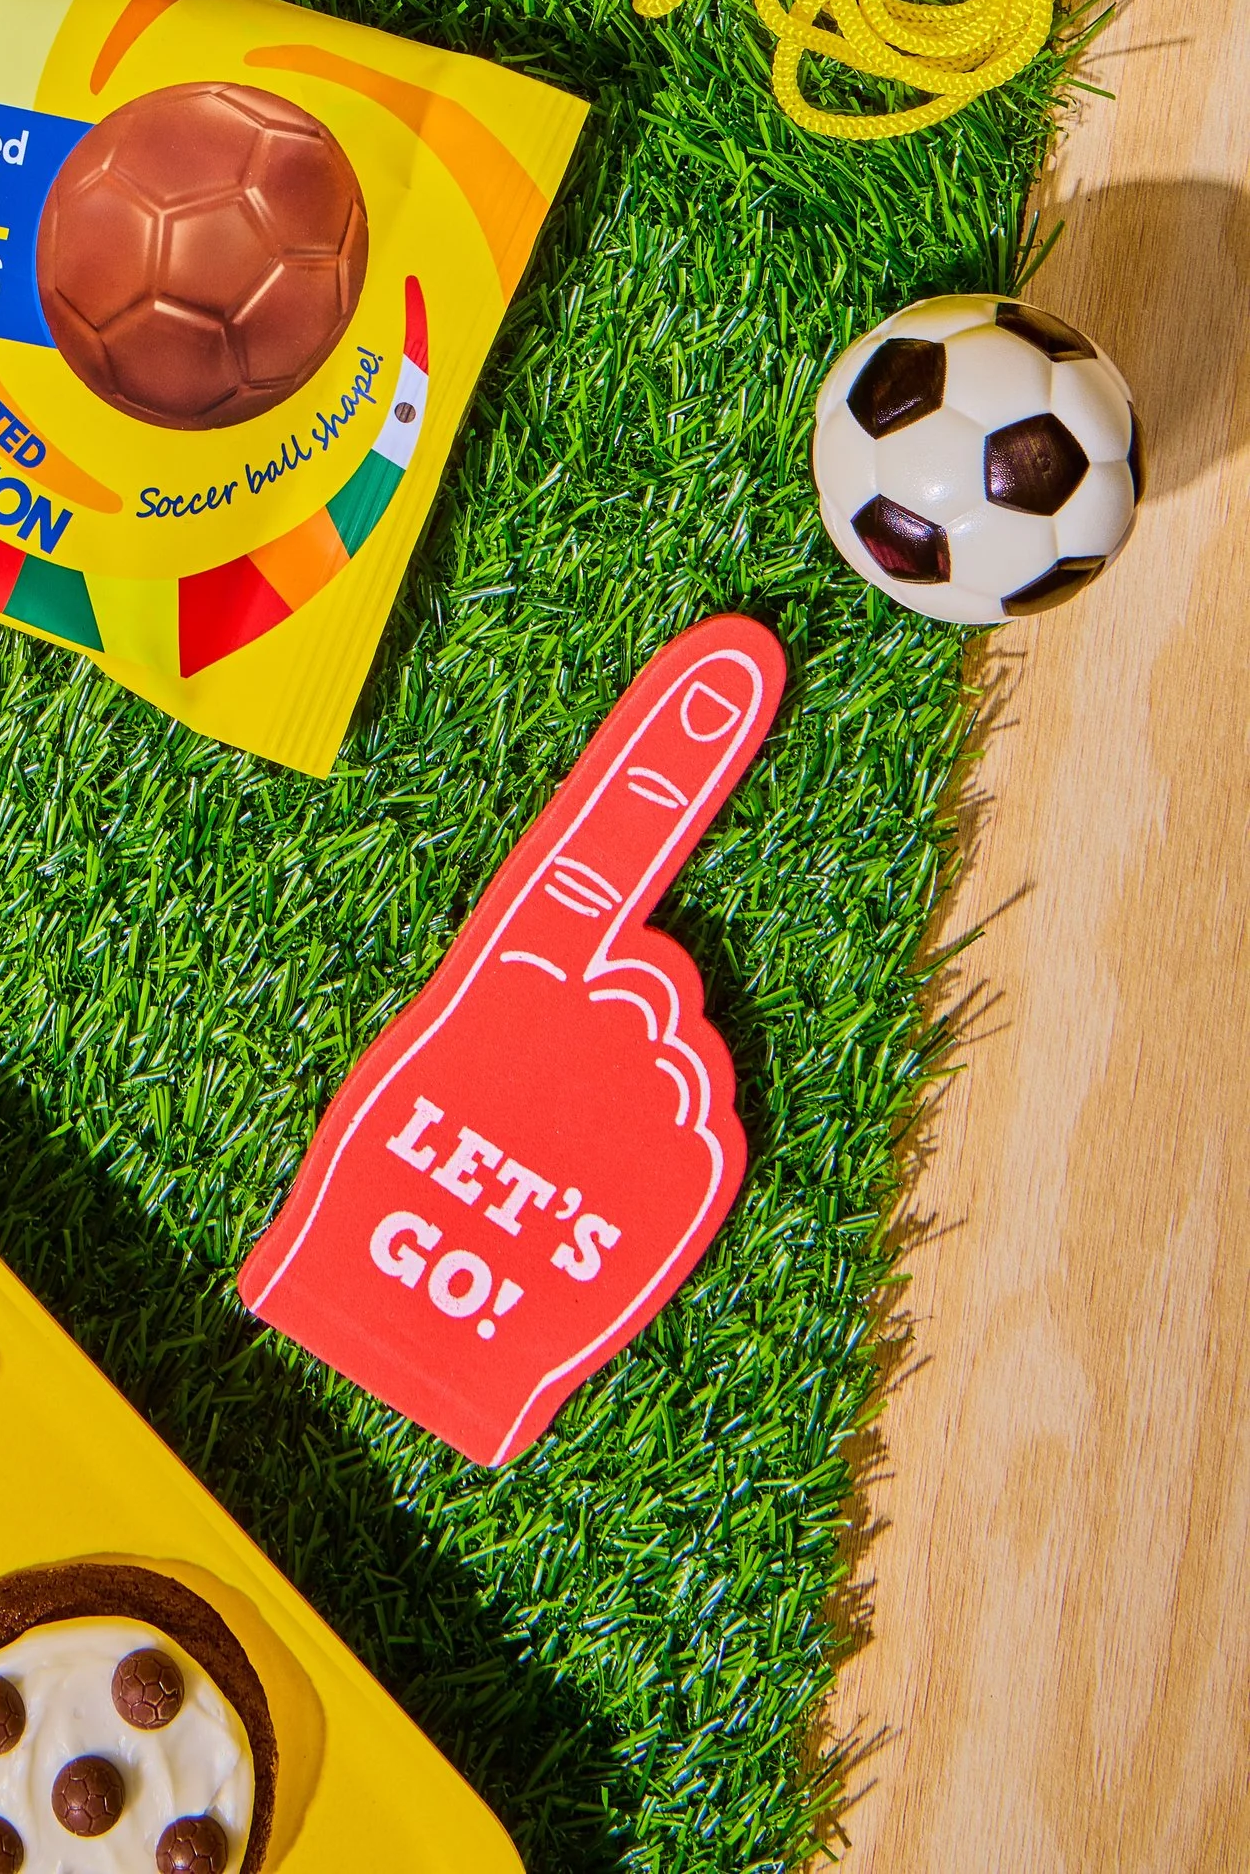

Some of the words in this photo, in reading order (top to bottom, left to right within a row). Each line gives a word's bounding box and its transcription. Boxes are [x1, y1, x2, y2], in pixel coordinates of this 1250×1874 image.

[136, 481, 238, 518] Soccer
[245, 434, 312, 494] ball
[312, 346, 384, 451] shape!
[385, 1095, 622, 1282] LET'S
[369, 1210, 524, 1340] GO!
